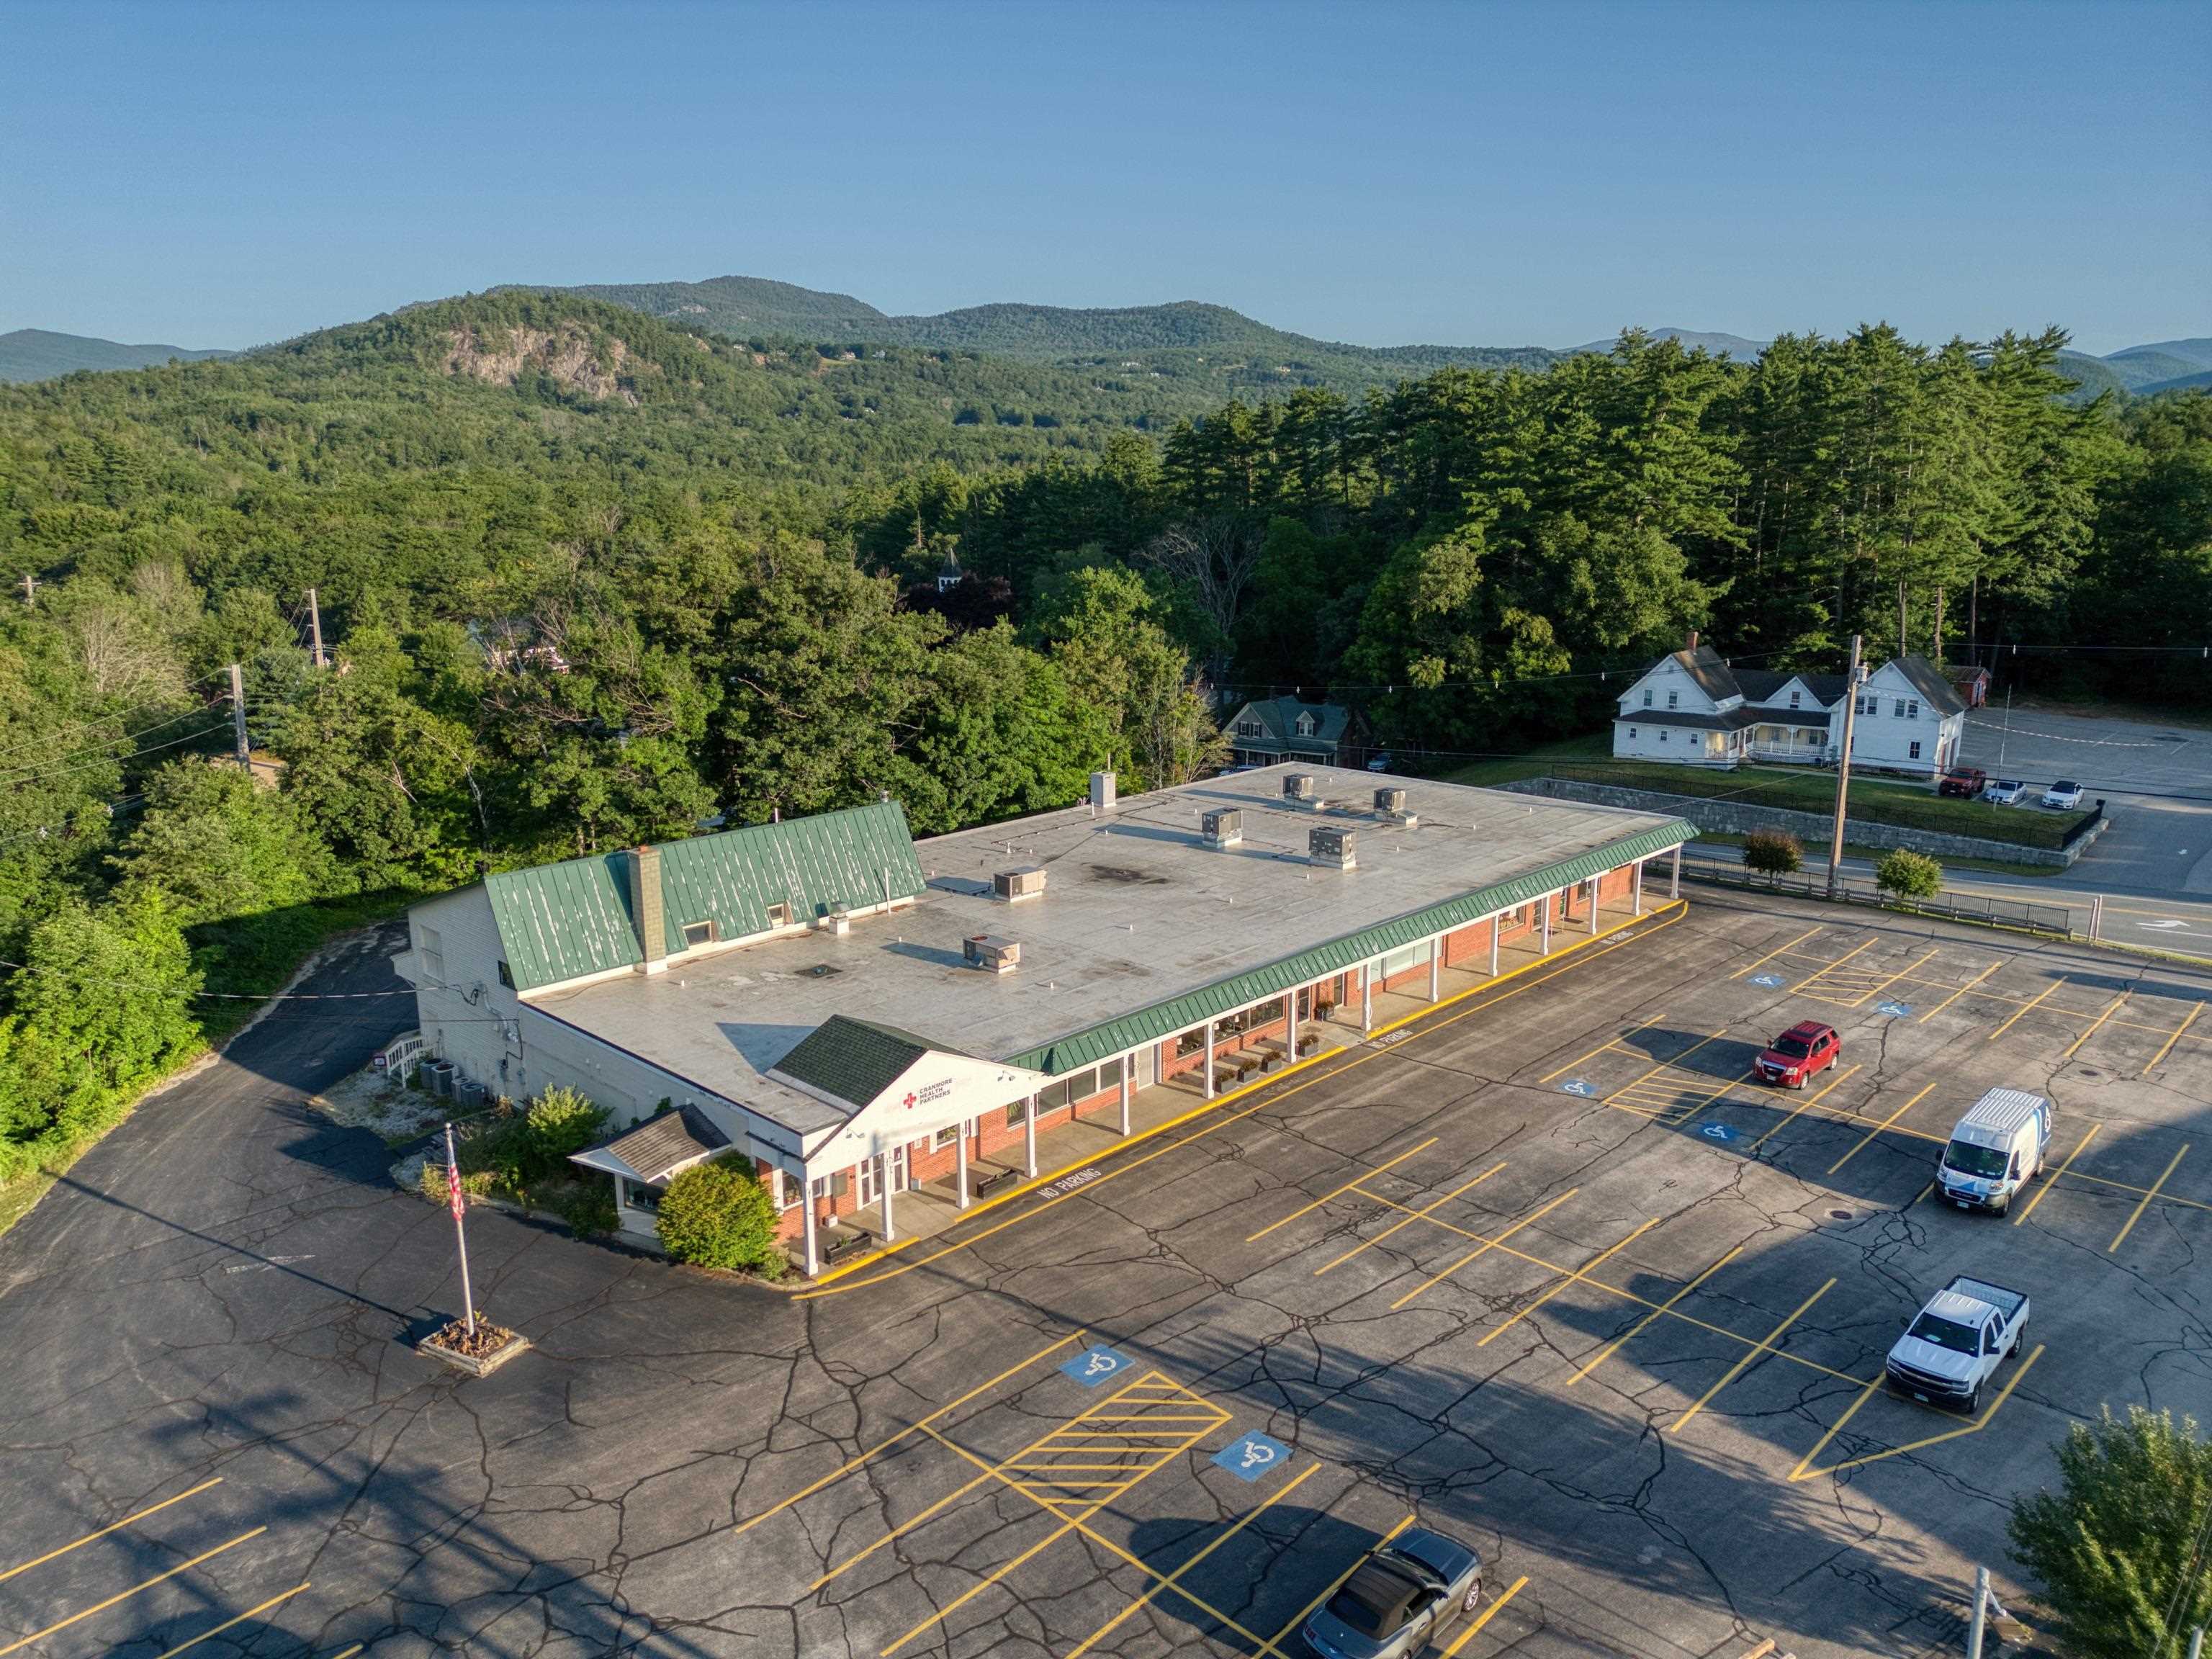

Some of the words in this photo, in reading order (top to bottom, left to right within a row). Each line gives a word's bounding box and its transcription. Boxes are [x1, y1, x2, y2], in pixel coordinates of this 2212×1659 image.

[919, 1078, 953, 1094] CRANMORE
[920, 1087, 943, 1099] HEALTH
[920, 1089, 950, 1105] PARTNERS
[1036, 1187, 1060, 1200] NO
[1054, 1168, 1102, 1192] PARKING
